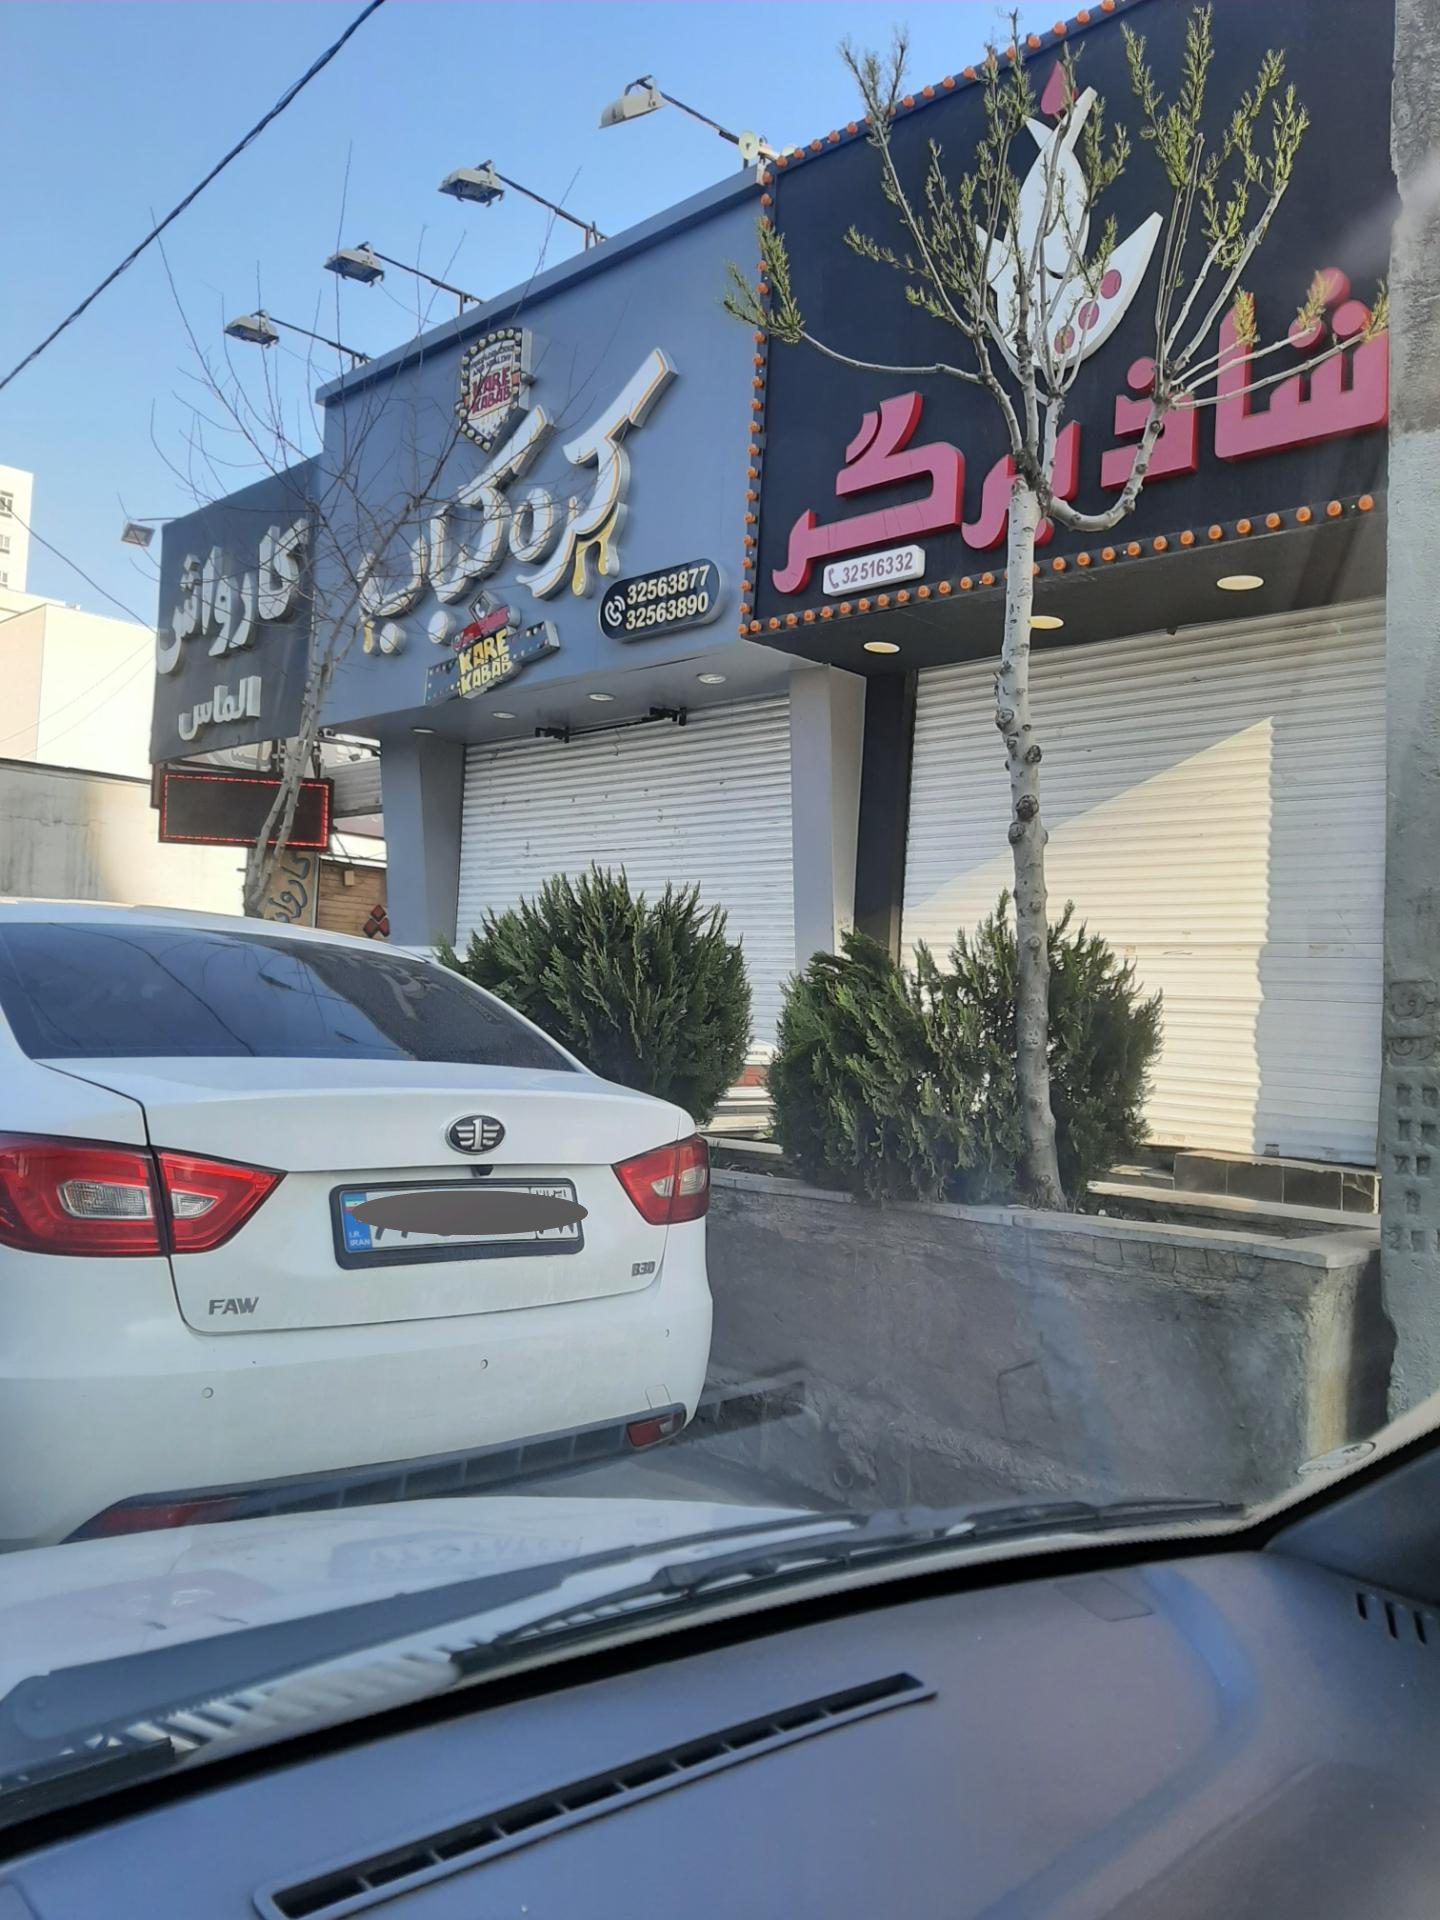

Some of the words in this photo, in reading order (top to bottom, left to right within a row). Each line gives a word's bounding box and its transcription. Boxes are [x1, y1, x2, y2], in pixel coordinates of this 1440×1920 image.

[627, 565, 710, 605] 32563877
[842, 552, 913, 584] 32516332
[157, 518, 308, 675] کارواش
[625, 592, 709, 630] 32563890
[459, 628, 509, 675] KARE
[459, 653, 513, 695] KABAB
[178, 676, 262, 741] الماس
[208, 1296, 259, 1315] FAW
